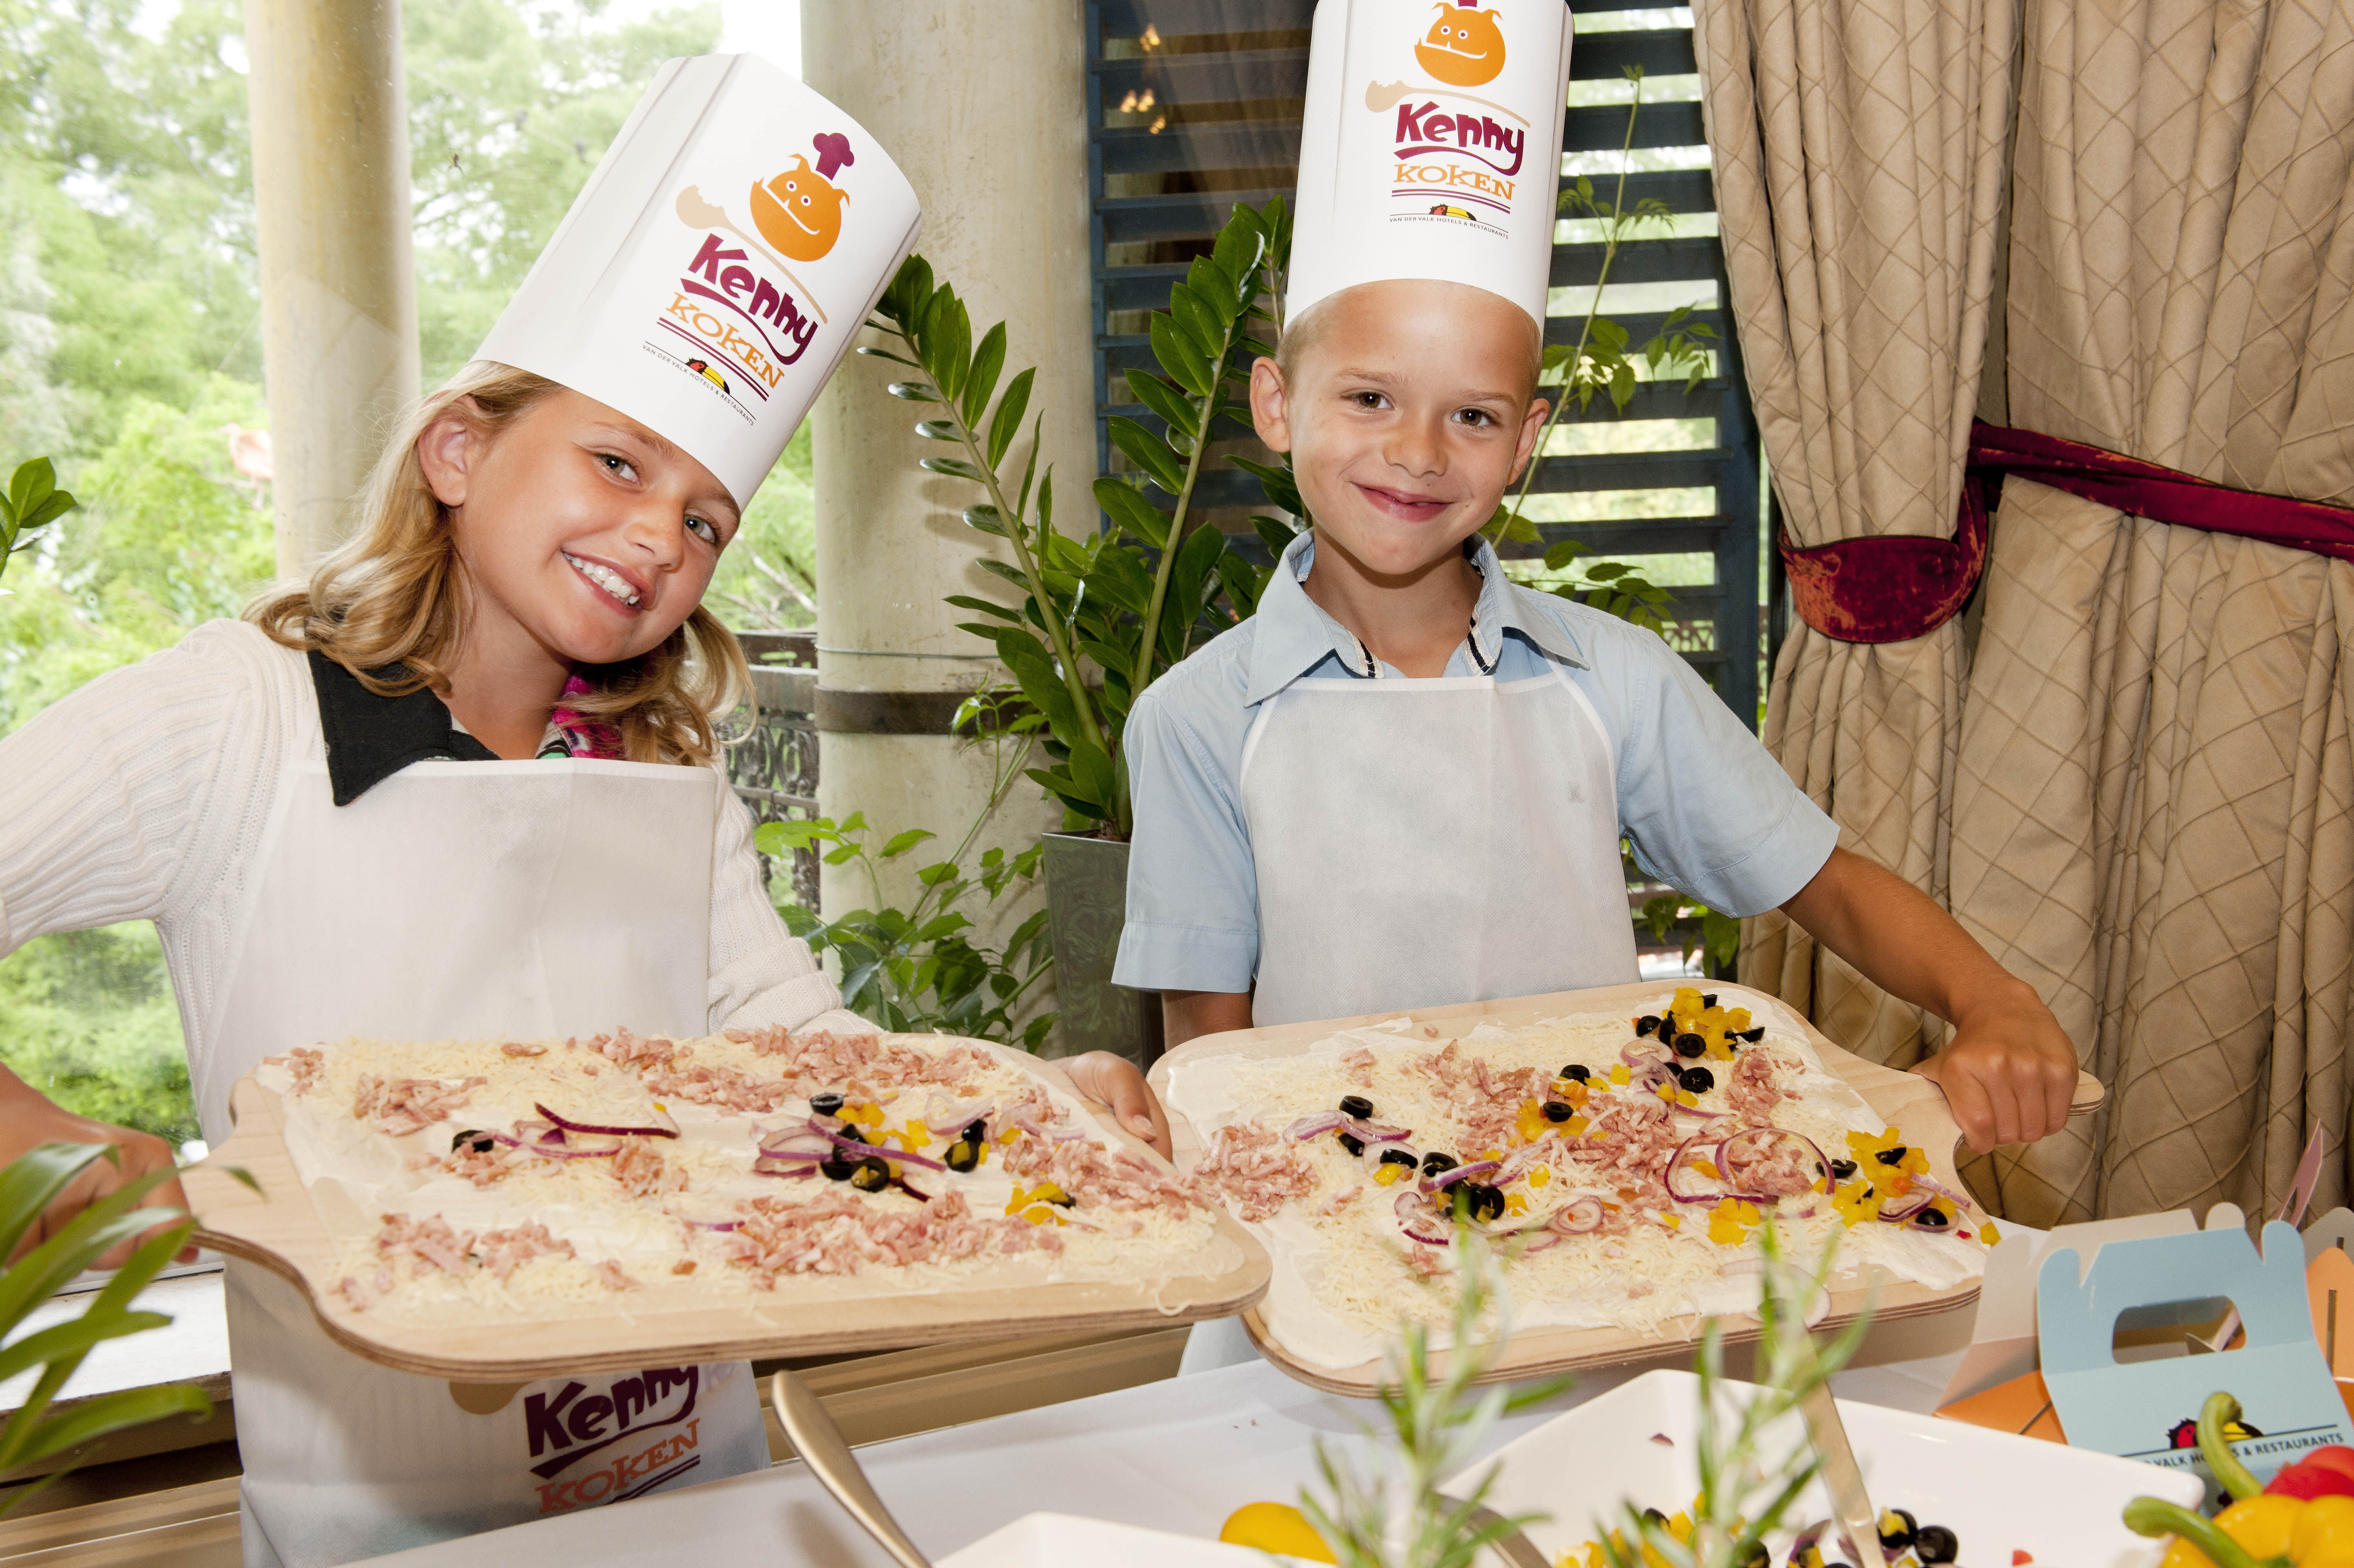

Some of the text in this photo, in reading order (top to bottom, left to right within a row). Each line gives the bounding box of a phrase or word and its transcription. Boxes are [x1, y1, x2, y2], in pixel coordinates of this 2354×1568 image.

[1394, 101, 1524, 176] Kenny
[1393, 163, 1516, 200] KOKEN
[1470, 223, 1509, 240] RESTAURANTS
[681, 233, 819, 365] Kenny
[666, 292, 785, 389] KOKEN
[642, 345, 655, 355] VAN
[657, 353, 670, 363] DER
[672, 361, 688, 374] VALK
[690, 372, 714, 391] HOTELS
[721, 394, 754, 426] RESTAURANTS
[525, 1365, 699, 1463] Kenny
[2244, 1447, 2252, 1456] &
[2254, 1433, 2344, 1455] RESTAURANTS
[535, 1418, 700, 1514] KOKEN
